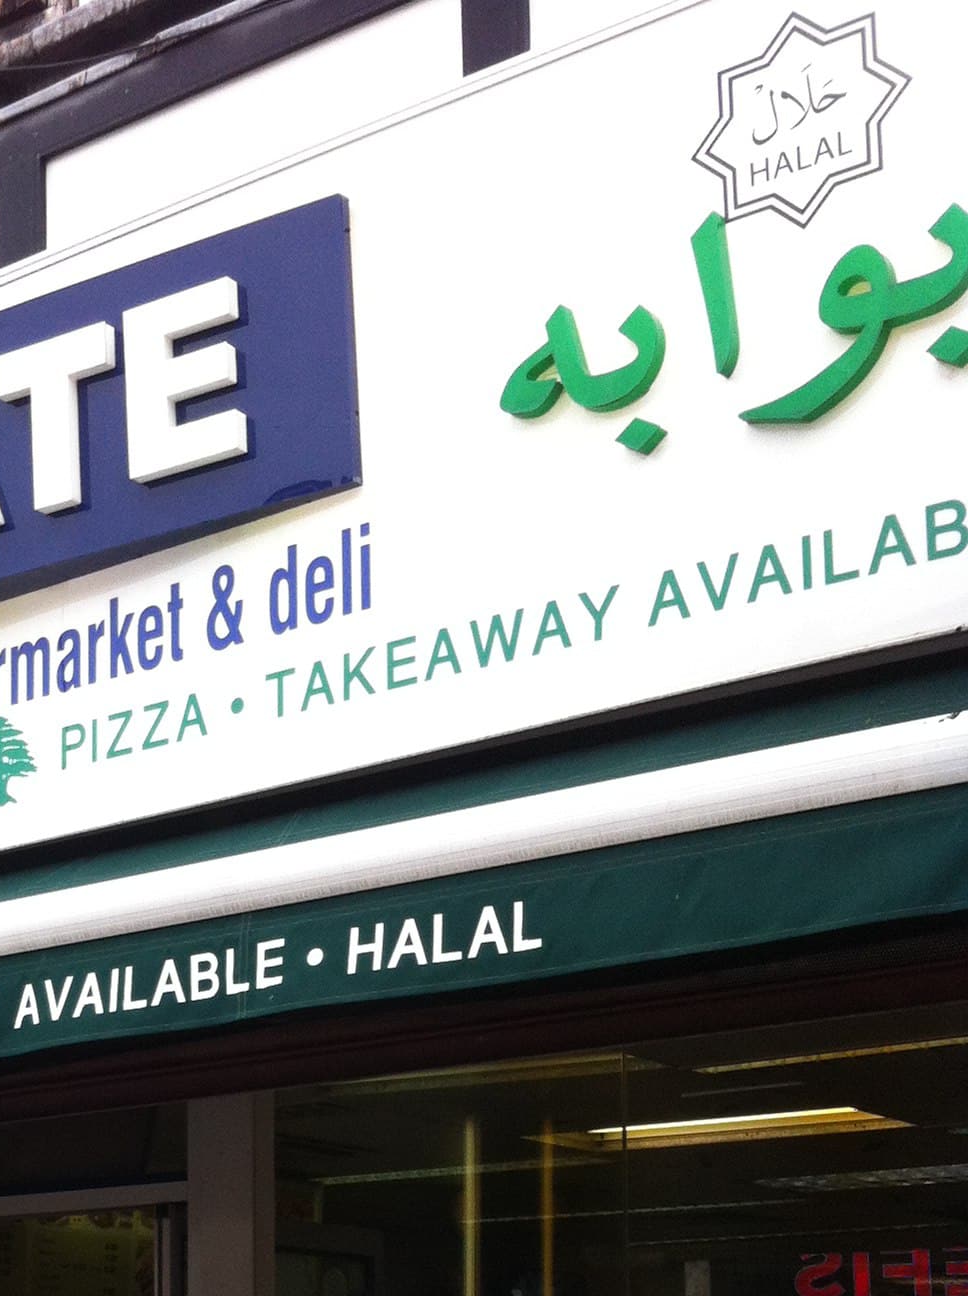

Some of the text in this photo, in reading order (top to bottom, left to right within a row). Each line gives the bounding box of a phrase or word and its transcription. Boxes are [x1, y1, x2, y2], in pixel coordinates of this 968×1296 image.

[749, 131, 853, 187] HALAL
[206, 564, 244, 650] &
[269, 522, 373, 636] deli
[61, 692, 208, 770] PIZZA
[265, 584, 621, 719] TAKEAWAY
[13, 938, 287, 1029] AVAILABLE
[345, 901, 544, 976] HALAL
